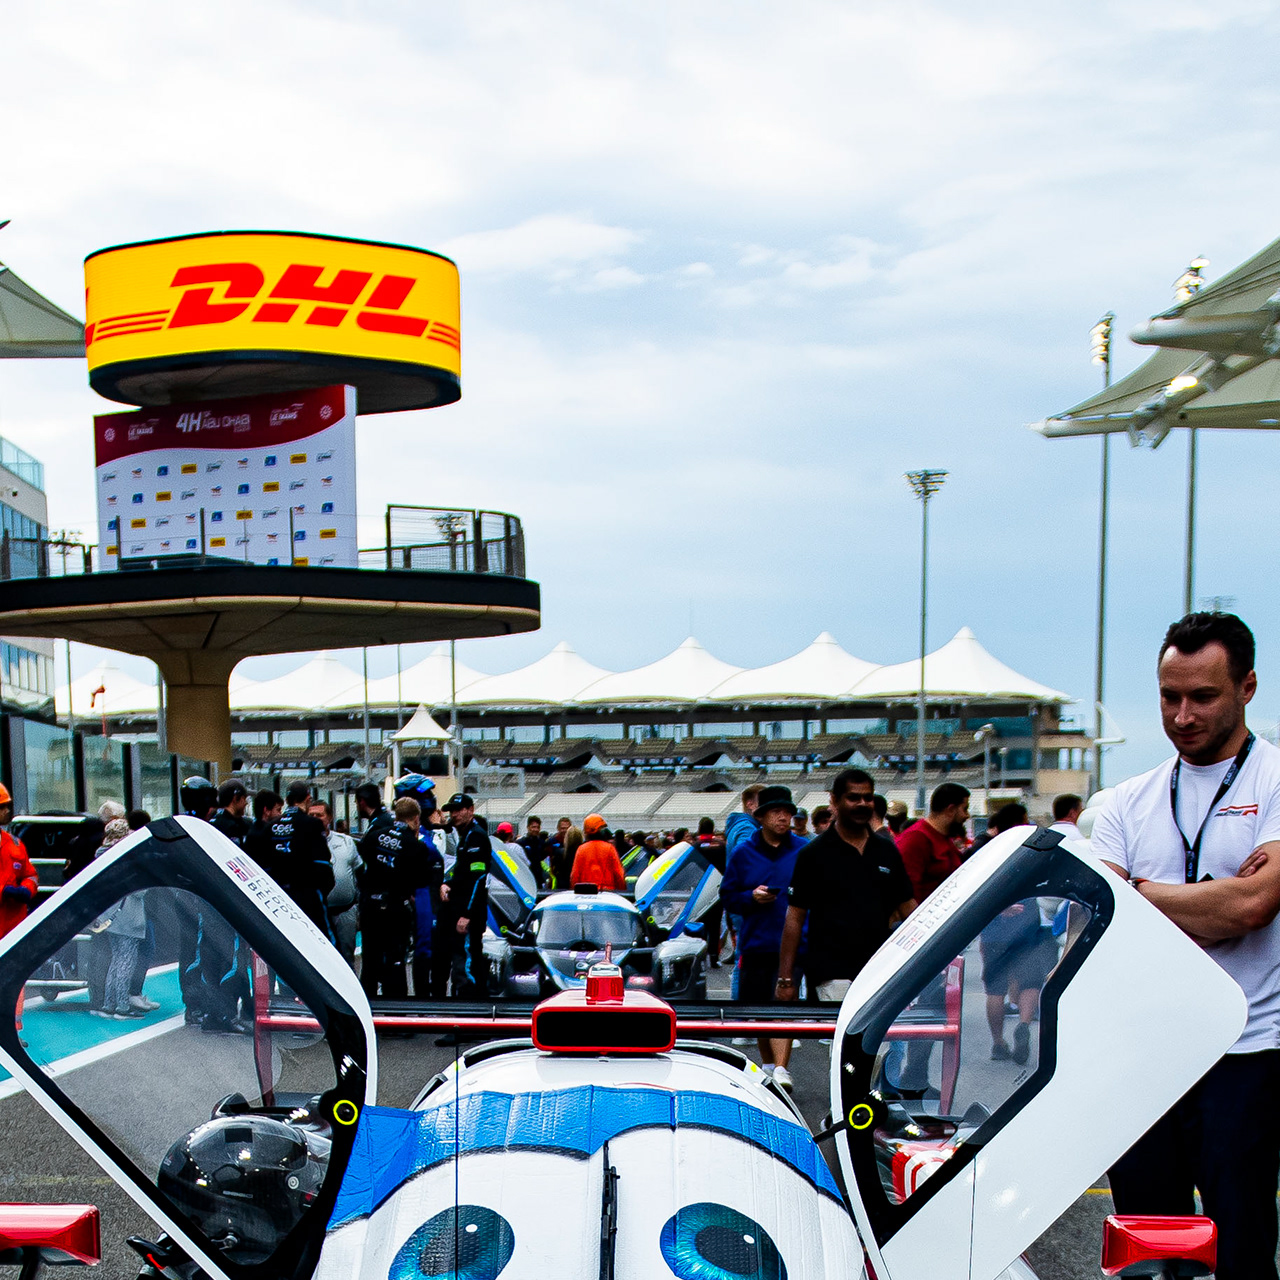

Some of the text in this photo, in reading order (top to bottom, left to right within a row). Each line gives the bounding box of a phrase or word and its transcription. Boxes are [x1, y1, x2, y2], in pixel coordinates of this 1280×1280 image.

[167, 262, 430, 337] DHL
[176, 411, 203, 433] 4H
[378, 833, 403, 849] COOL
[247, 881, 281, 919] BELL
[255, 878, 298, 921] LIDDY
